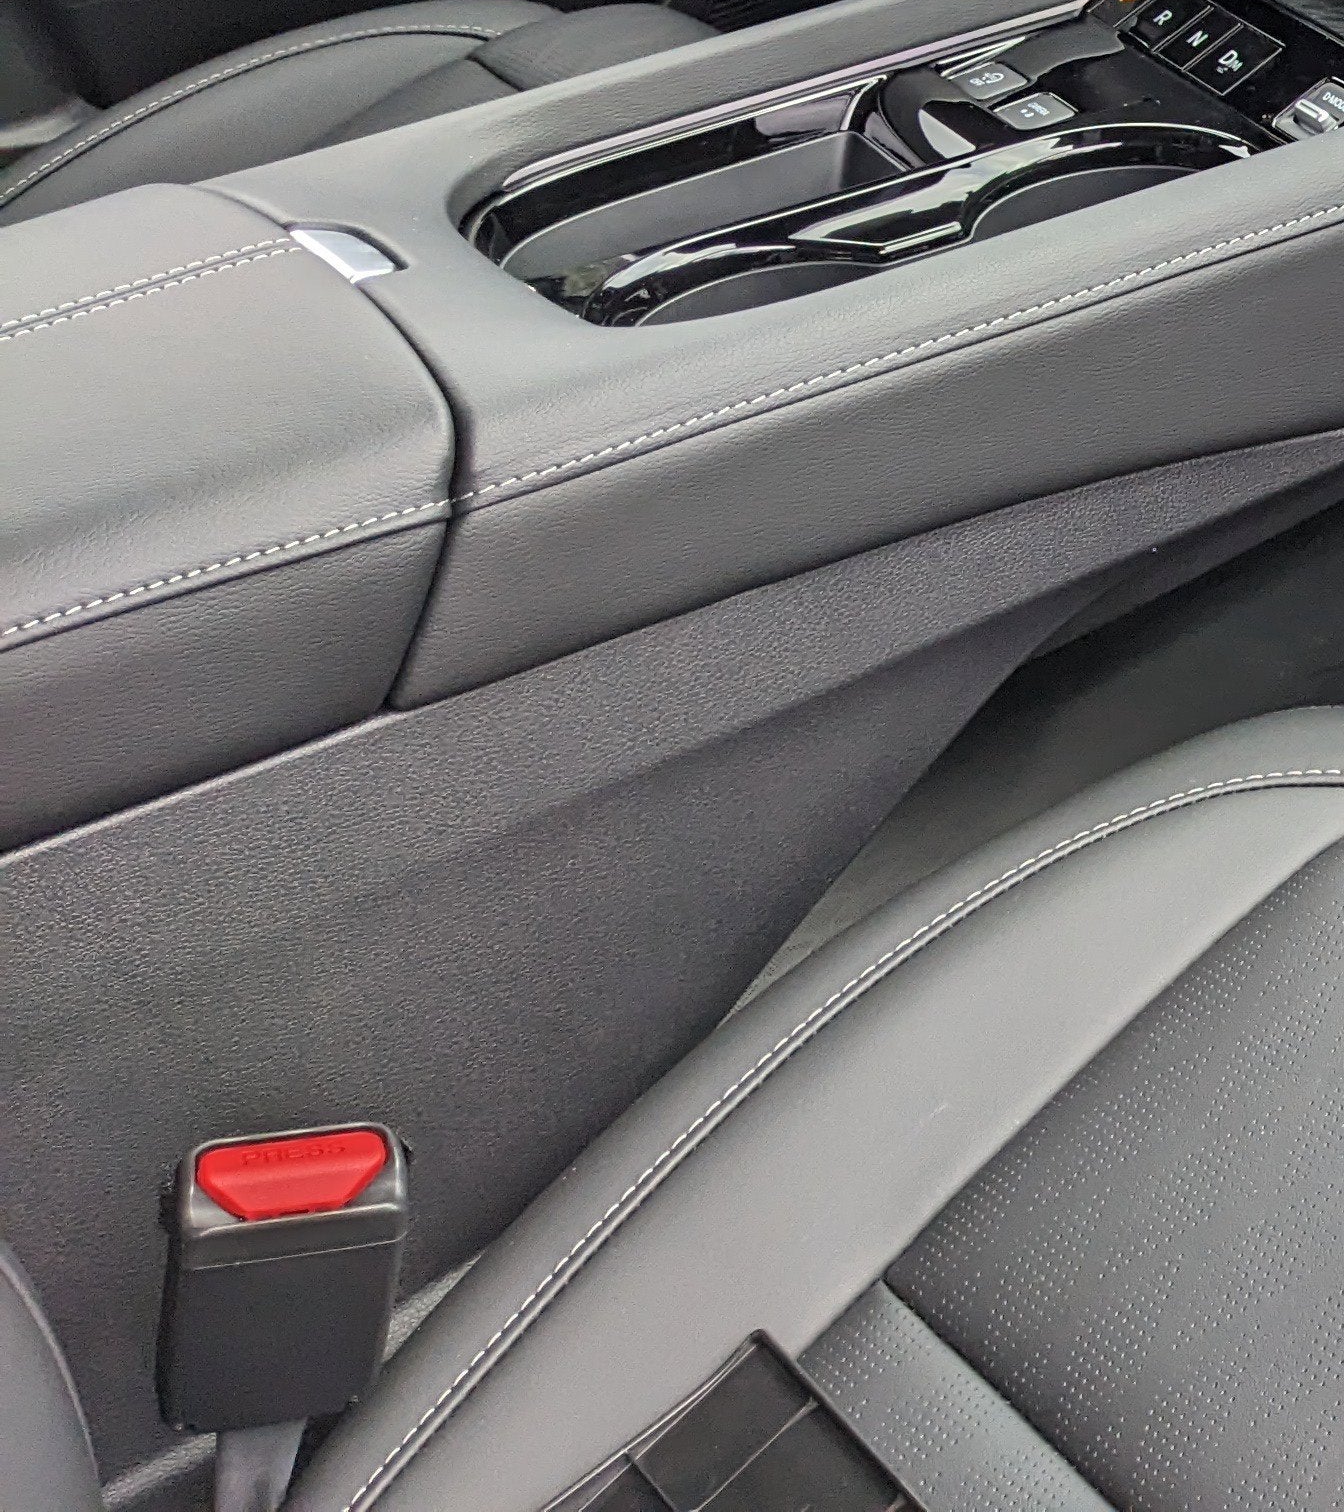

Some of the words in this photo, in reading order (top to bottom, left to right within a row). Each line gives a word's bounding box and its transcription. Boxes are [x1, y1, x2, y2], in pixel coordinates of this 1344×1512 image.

[1152, 9, 1173, 27] R
[1185, 30, 1209, 48] N
[241, 1144, 346, 1166] PRESS
